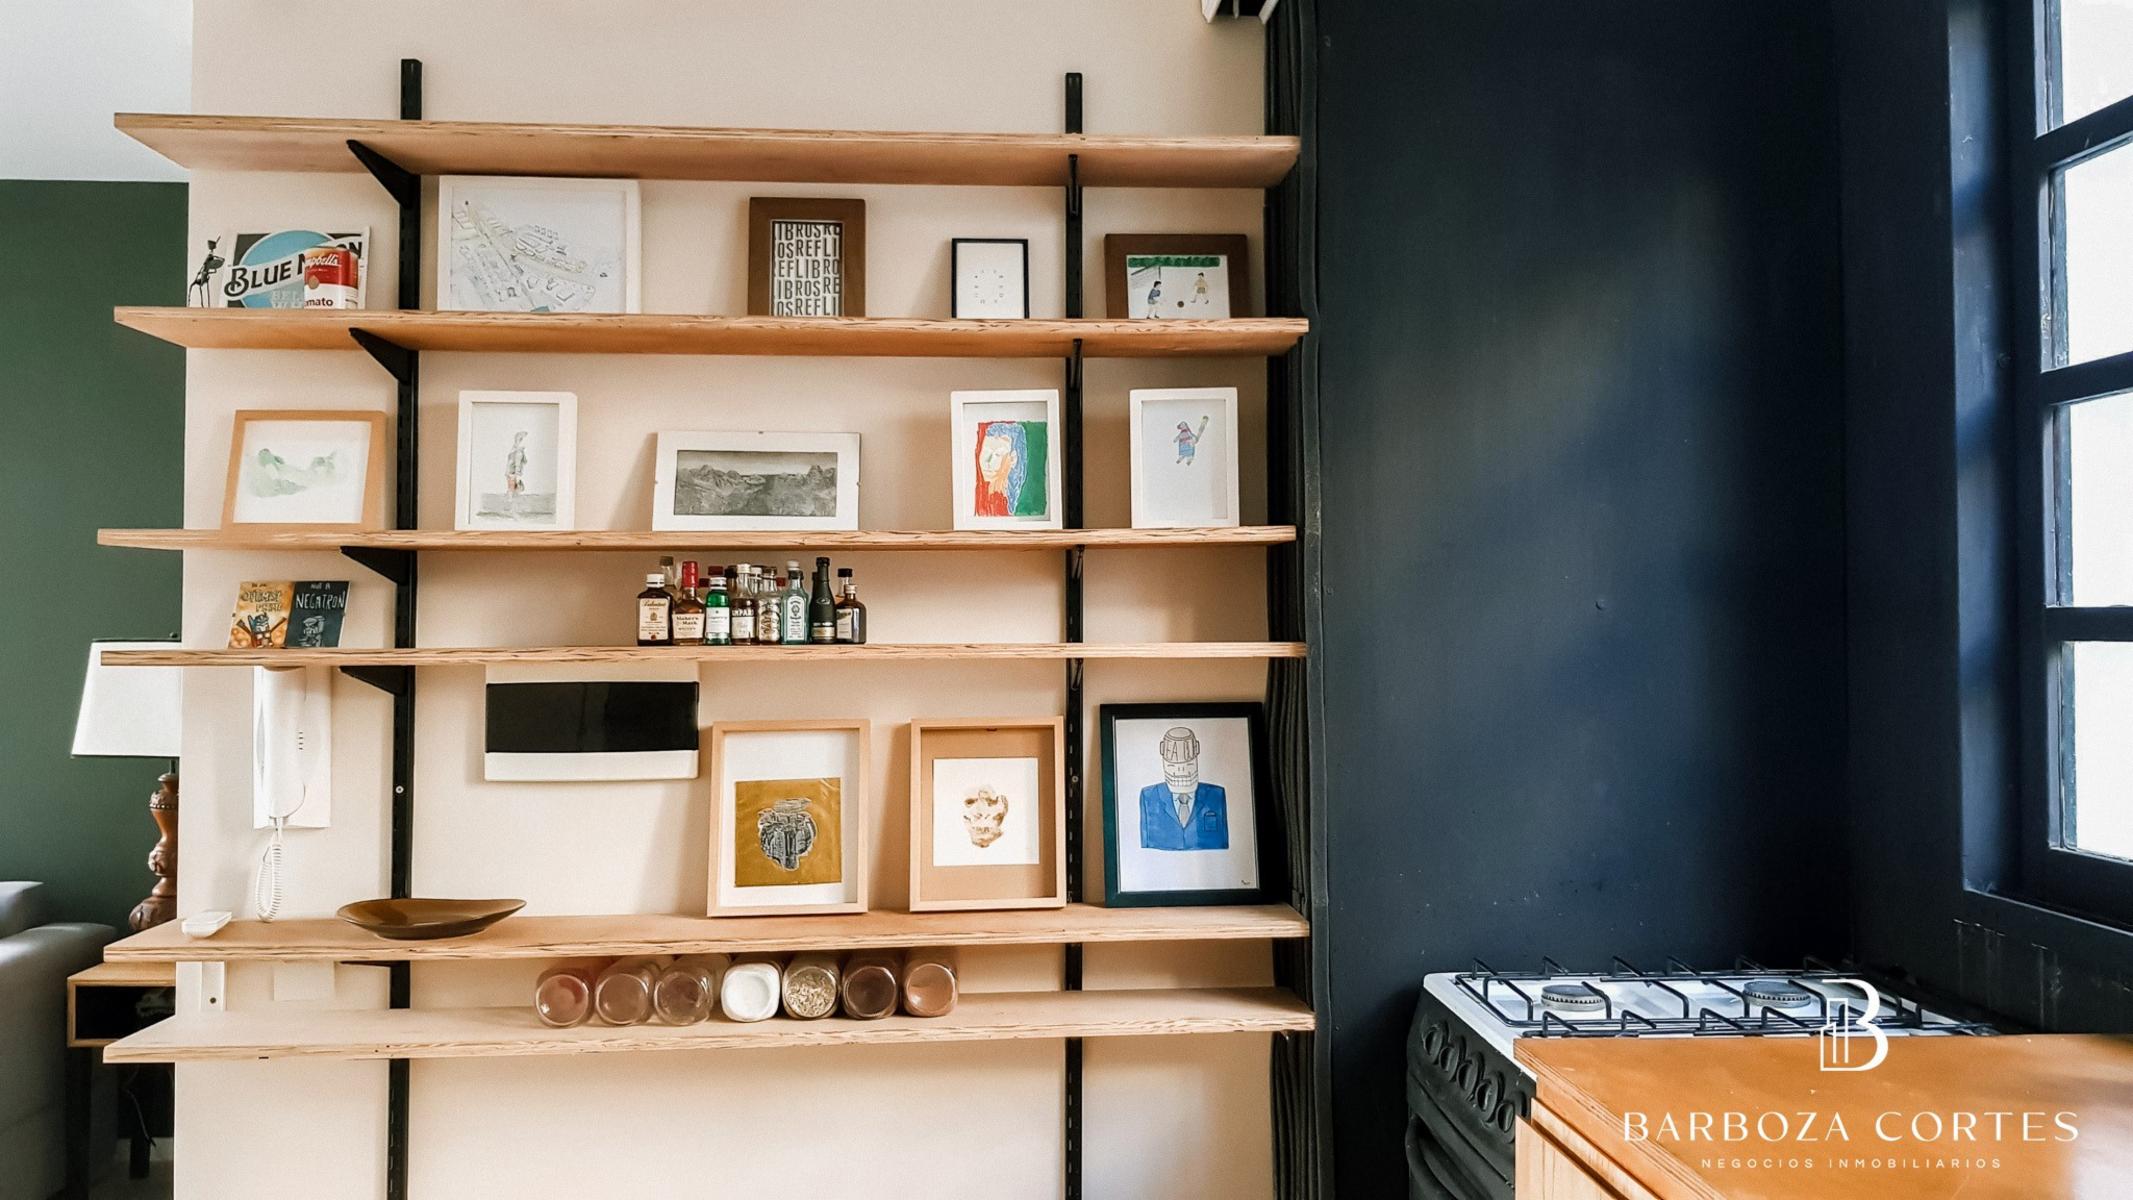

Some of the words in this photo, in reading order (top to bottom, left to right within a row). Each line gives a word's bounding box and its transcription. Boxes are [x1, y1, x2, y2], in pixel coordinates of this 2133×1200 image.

[777, 237, 837, 258] OSREFLI
[224, 260, 292, 297] BLUE
[778, 259, 840, 278] EFLIBRO
[777, 296, 837, 317] OSREFLI
[296, 591, 345, 609] NEGATRON
